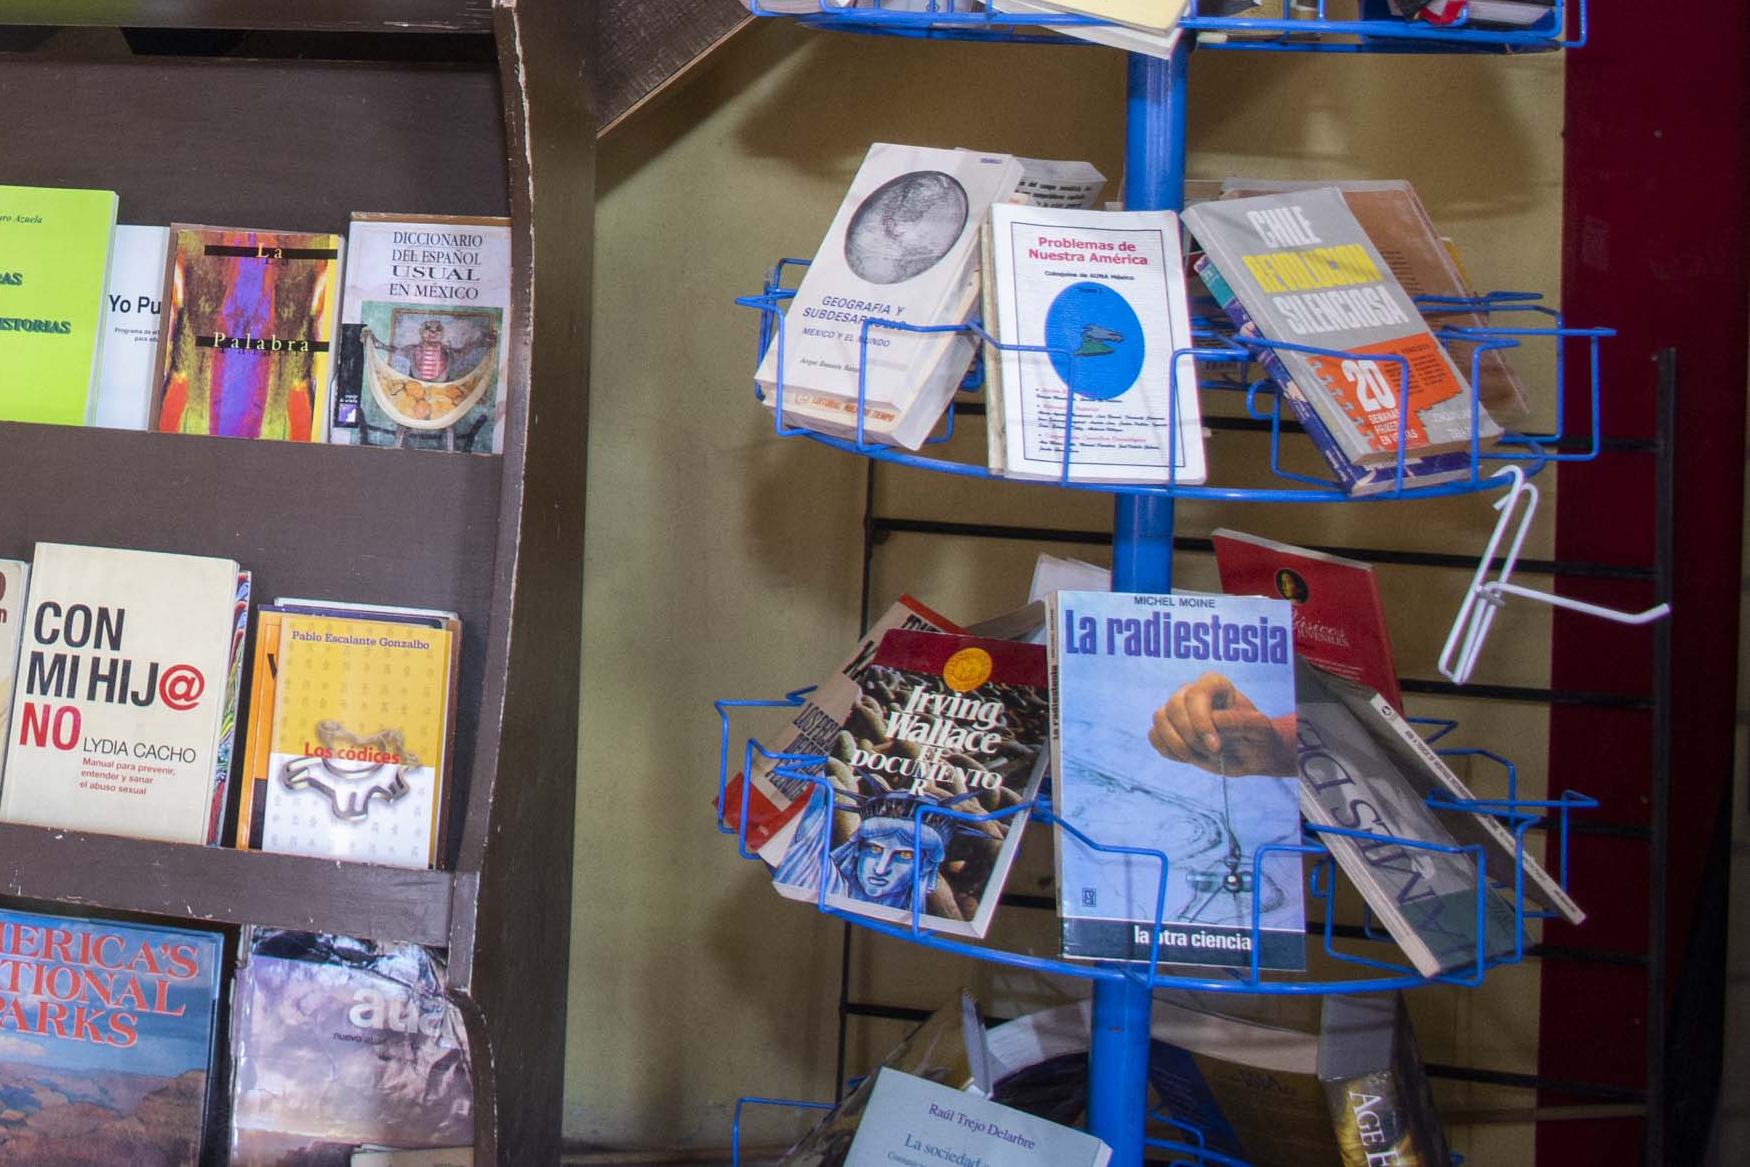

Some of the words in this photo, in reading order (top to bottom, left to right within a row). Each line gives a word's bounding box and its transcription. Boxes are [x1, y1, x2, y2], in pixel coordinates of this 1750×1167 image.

[13, 215, 42, 224] Azuela
[1246, 205, 1323, 249] CHILE
[393, 231, 483, 247] DICCIONARIO
[1038, 237, 1114, 251] Problemas
[1118, 241, 1137, 252] de
[256, 242, 283, 259] La
[392, 249, 418, 263] DEL
[421, 249, 482, 266] ESPAÑOL
[1028, 249, 1086, 262] Nuestra
[1090, 250, 1149, 266] América
[392, 265, 481, 281] USUAL
[389, 283, 410, 296] EN
[415, 283, 479, 300] MÉXICO
[213, 332, 309, 352] Palabra
[1133, 595, 1176, 607] MICHEL
[1178, 597, 1216, 609] MOINE
[34, 600, 125, 652] CON
[292, 630, 323, 642] Pablo
[325, 633, 377, 647] Escalante
[379, 637, 431, 650] Gonzalbo
[1065, 609, 1098, 655] La
[1106, 610, 1288, 665] radiestesia
[26, 650, 80, 699] MI
[87, 656, 205, 711] HIJ@
[905, 685, 1003, 730] Irving
[19, 701, 82, 751] NO
[885, 710, 1002, 755] Wallace
[83, 737, 128, 758] LYDIA
[133, 742, 197, 764] CACHO
[303, 741, 334, 760] Los
[337, 743, 400, 765] códices
[81, 769, 119, 782] entender
[121, 774, 127, 783] y
[128, 774, 154, 784] sanar
[82, 757, 115, 769] Manual
[116, 760, 135, 773] para
[138, 763, 177, 777] prevenir,
[850, 748, 1003, 791] DOCUMENTO
[79, 780, 88, 789] el
[89, 781, 117, 792] abuso
[118, 784, 147, 795] sexual
[928, 1103, 956, 1122] Raúl
[957, 1112, 986, 1134] Trejo
[987, 1124, 1036, 1150] Delarbre
[1348, 1091, 1385, 1147] AGE
